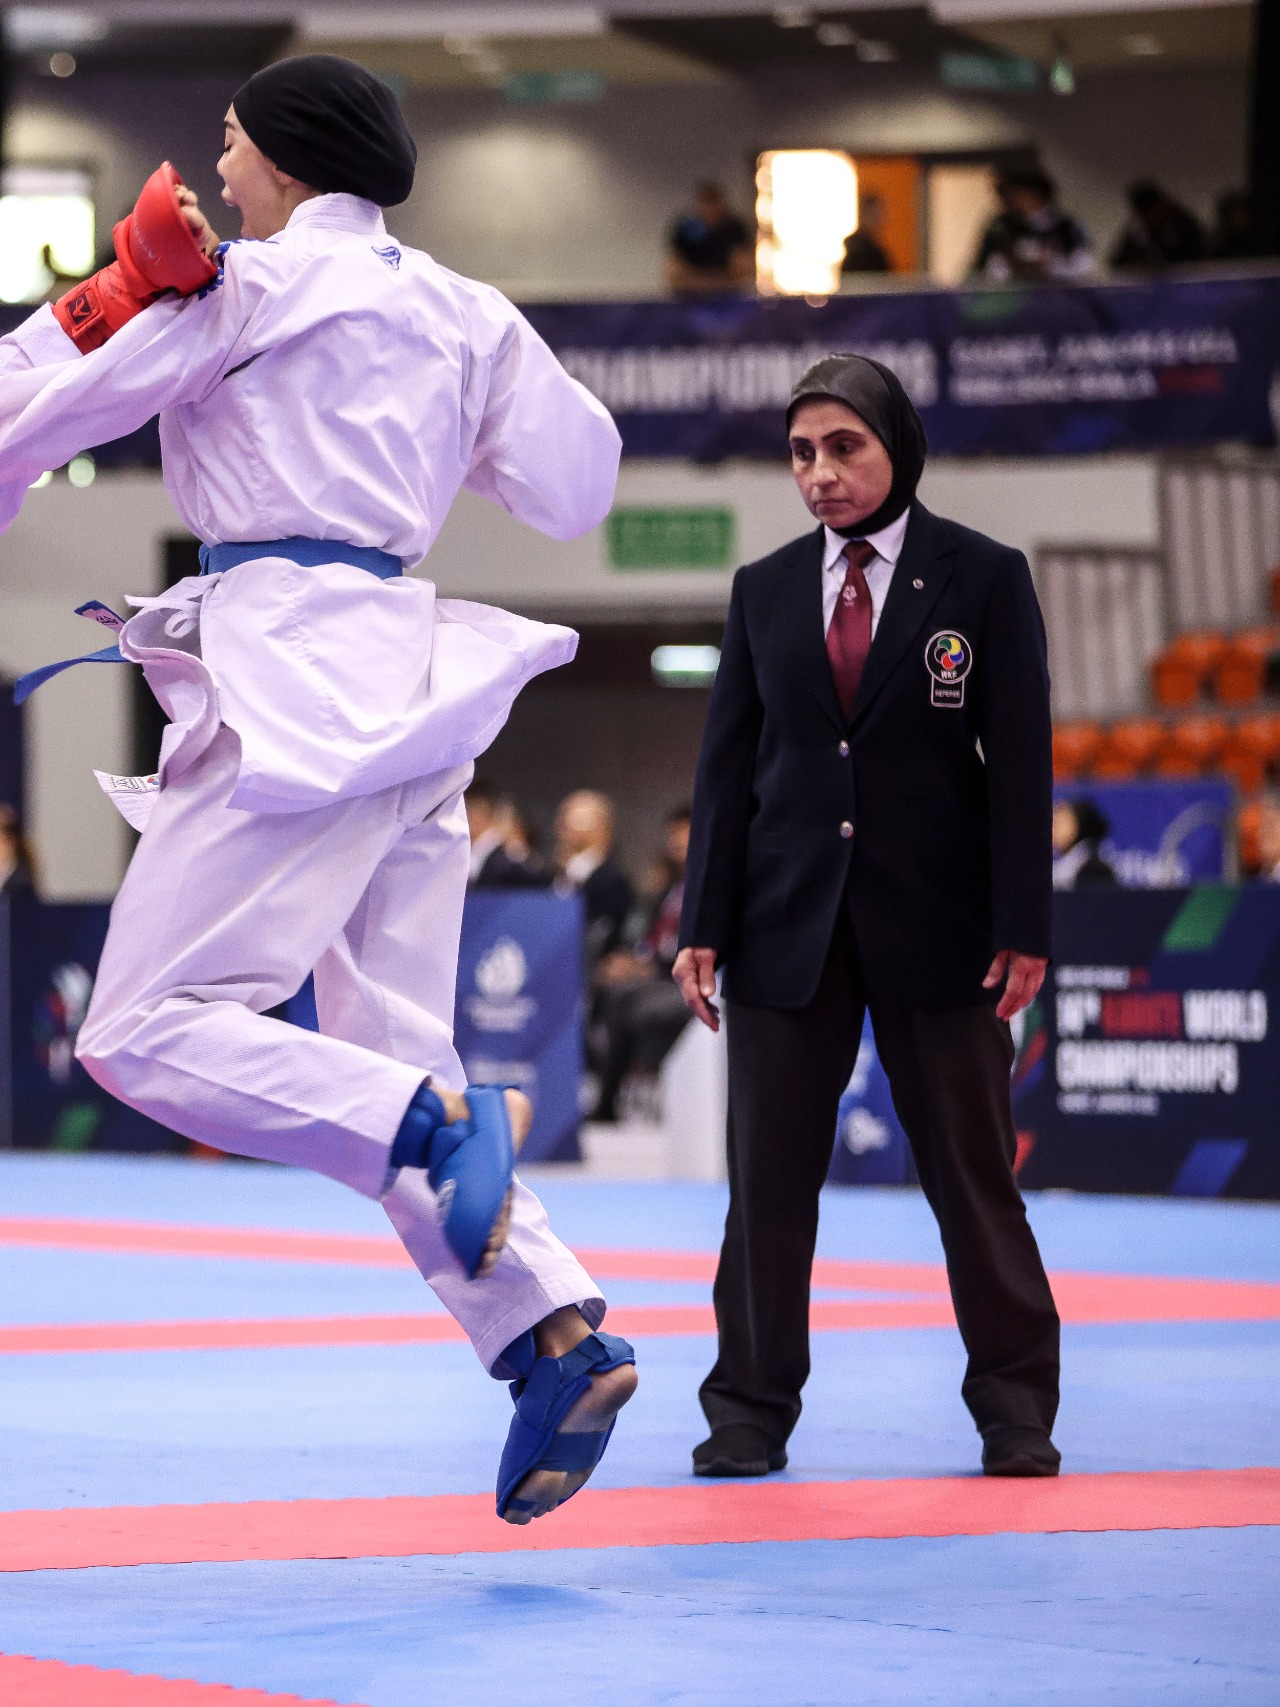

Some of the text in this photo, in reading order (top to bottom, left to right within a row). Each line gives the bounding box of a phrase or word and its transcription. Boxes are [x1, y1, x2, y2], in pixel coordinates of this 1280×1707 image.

[940, 669, 958, 679] WKF
[1183, 988, 1268, 1042] WORLD
[1056, 1038, 1238, 1094] CHAMPIONSHIPS
